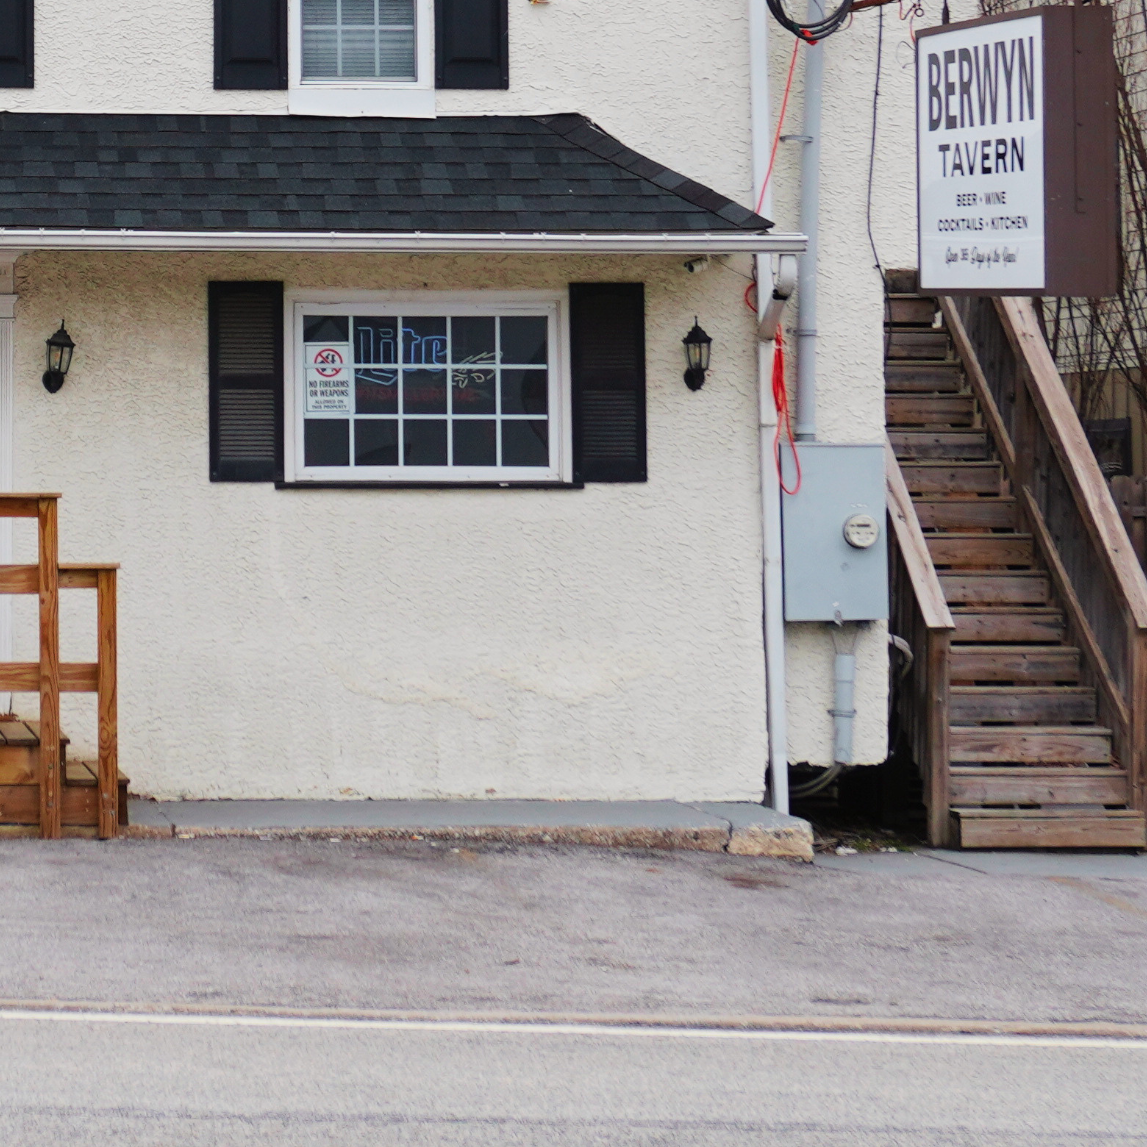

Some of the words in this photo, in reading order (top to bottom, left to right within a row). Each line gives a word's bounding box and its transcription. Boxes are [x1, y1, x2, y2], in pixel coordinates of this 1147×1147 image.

[927, 36, 1035, 132] BERWYN
[938, 136, 1025, 177] TAVERN
[956, 193, 977, 207] BEER
[984, 191, 1006, 205] WINE
[937, 217, 983, 231] COCKTAILS
[991, 215, 1028, 230] KITCHEN
[308, 380, 318, 388] NO
[319, 380, 349, 388] FIREARMS
[309, 389, 318, 397] OR
[320, 389, 349, 397] WEAPONS
